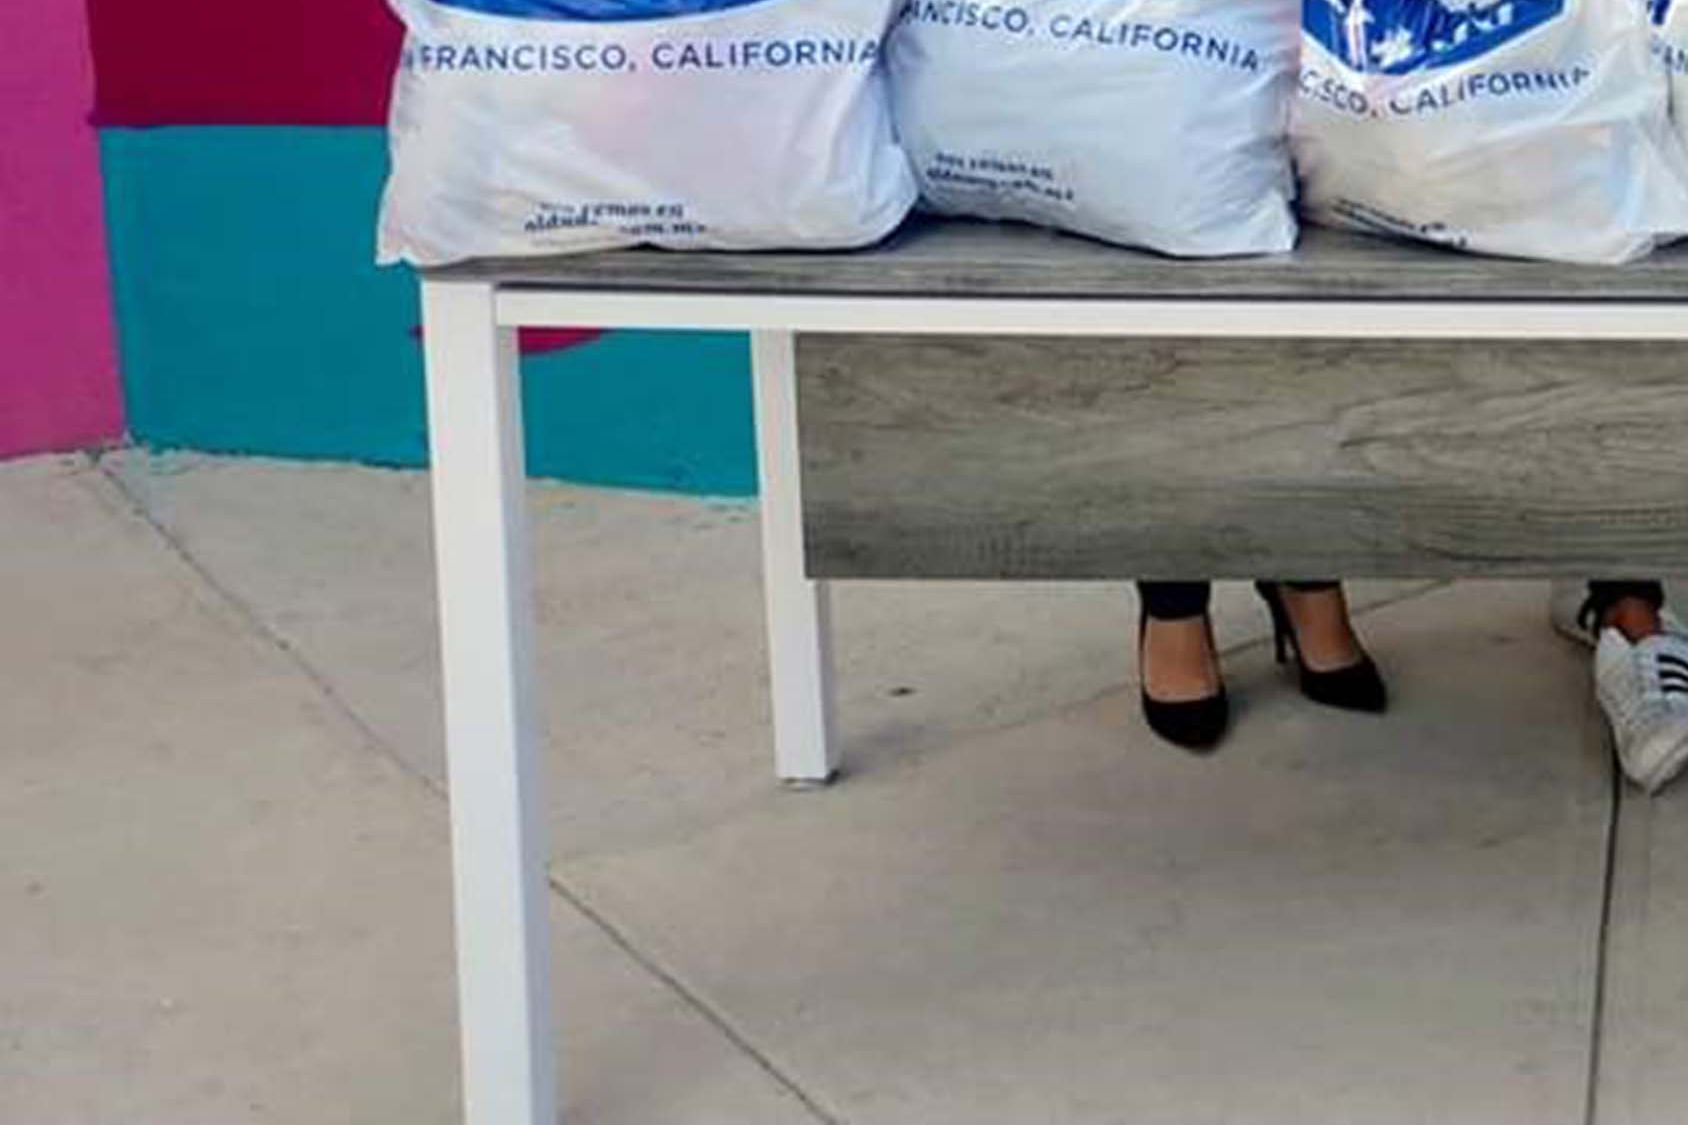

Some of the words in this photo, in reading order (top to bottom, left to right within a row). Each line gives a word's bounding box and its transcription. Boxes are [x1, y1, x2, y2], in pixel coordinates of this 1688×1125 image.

[420, 43, 639, 73] FRANCISCO,
[650, 37, 881, 72] CALIFORNIA
[1049, 13, 1259, 72] CALIFORNIA
